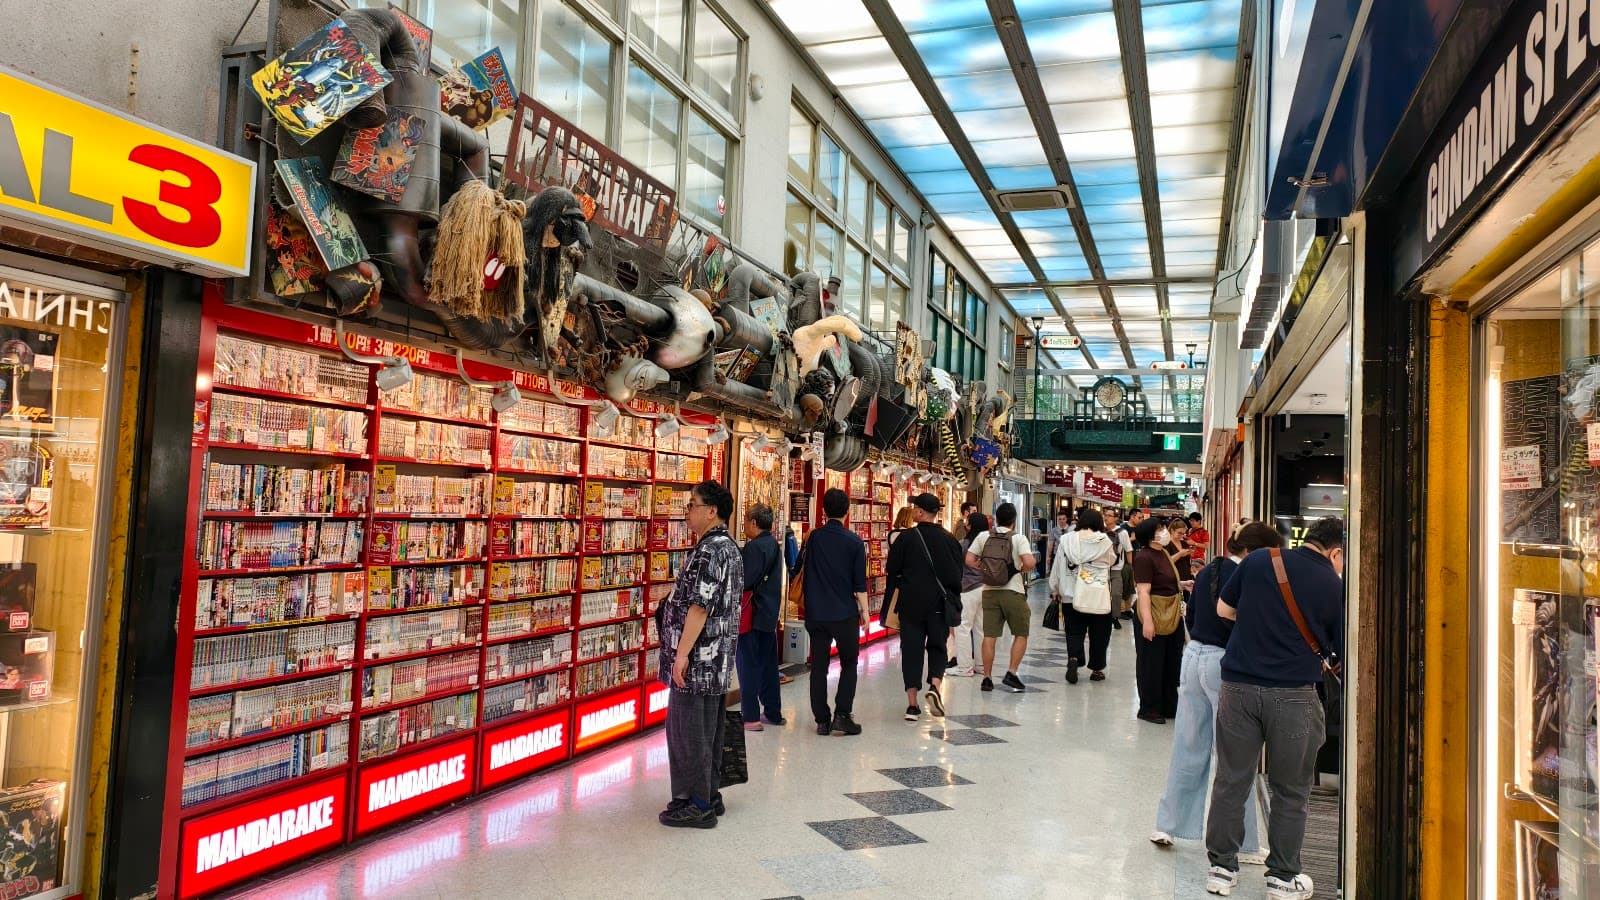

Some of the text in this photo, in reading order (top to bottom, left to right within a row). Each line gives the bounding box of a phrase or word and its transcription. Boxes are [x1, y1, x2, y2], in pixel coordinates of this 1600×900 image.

[1426, 44, 1518, 243] GUNDAM
[122, 143, 222, 248] 3
[312, 325, 367, 352] 1冊10円
[490, 723, 563, 771] MANDARAKE
[580, 699, 637, 739] MANDARAKE
[368, 753, 466, 813] MANDARAKE
[196, 795, 334, 874] MANDARAKE
